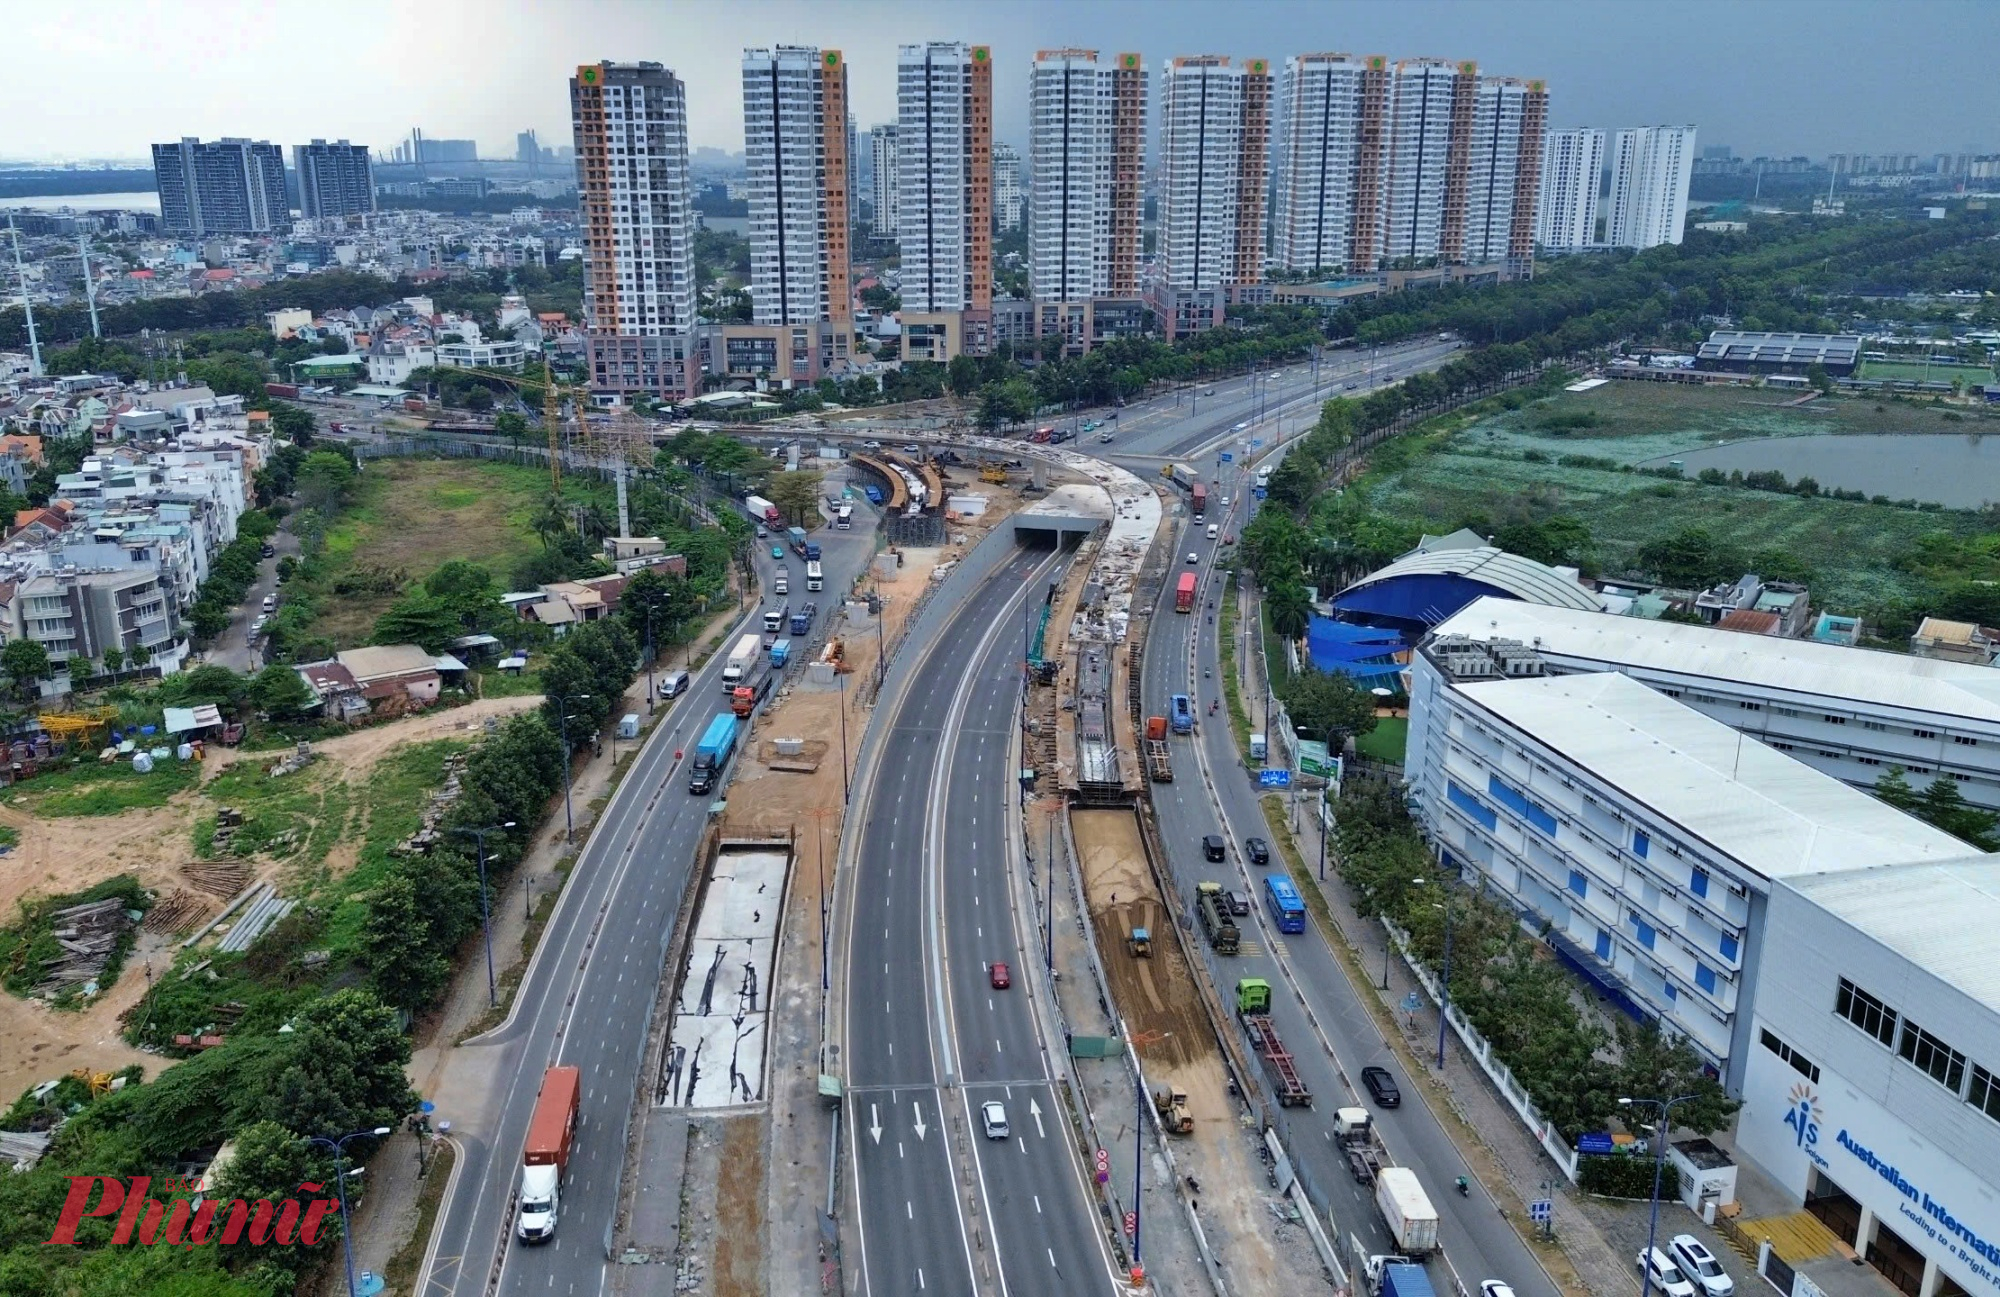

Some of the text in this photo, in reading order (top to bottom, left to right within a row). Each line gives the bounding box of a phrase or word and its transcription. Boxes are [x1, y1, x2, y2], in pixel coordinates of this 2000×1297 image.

[1804, 1143, 1829, 1170] Saigon
[1836, 1129, 2000, 1269] Australian Internati
[1899, 1202, 2000, 1290] Leading to a Bright F
